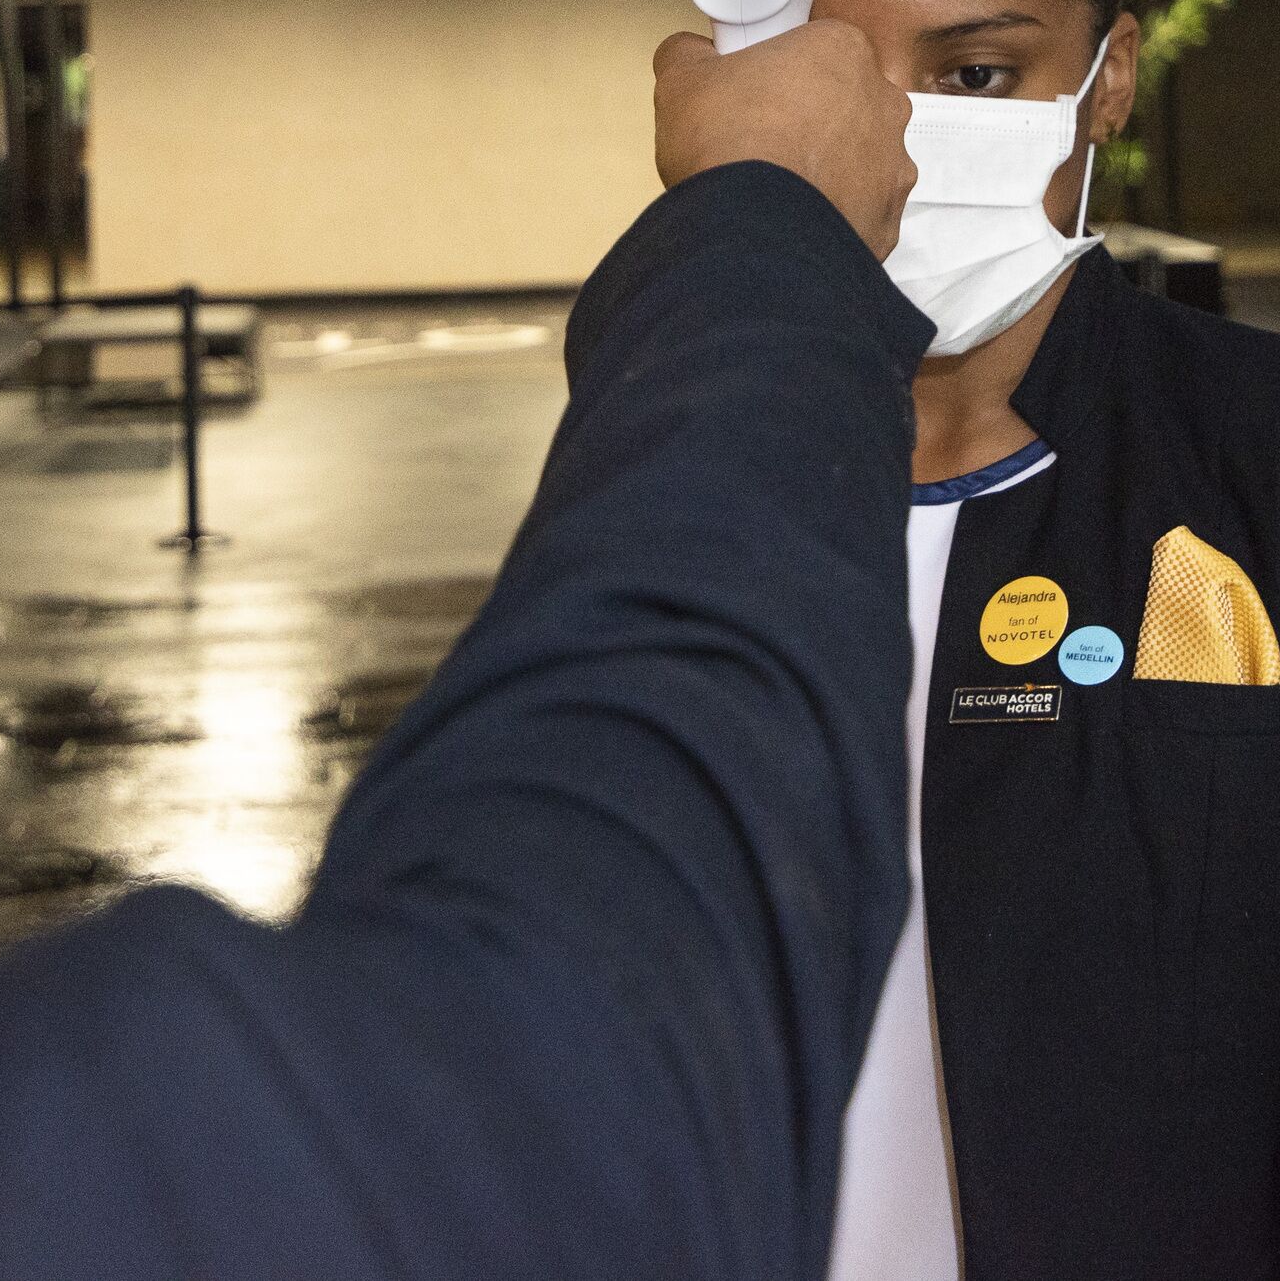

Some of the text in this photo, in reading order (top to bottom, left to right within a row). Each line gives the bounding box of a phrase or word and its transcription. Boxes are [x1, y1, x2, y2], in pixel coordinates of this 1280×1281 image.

[998, 591, 1056, 605] Alejandra
[1009, 616, 1039, 626] fan of
[987, 630, 1055, 643] NOVOTEL
[1080, 644, 1091, 652] fan
[1066, 652, 1114, 663] MEDELLIN
[976, 695, 1007, 705] CLUB
[1008, 694, 1053, 704] ACCOR
[1006, 704, 1051, 713] HOTELS
